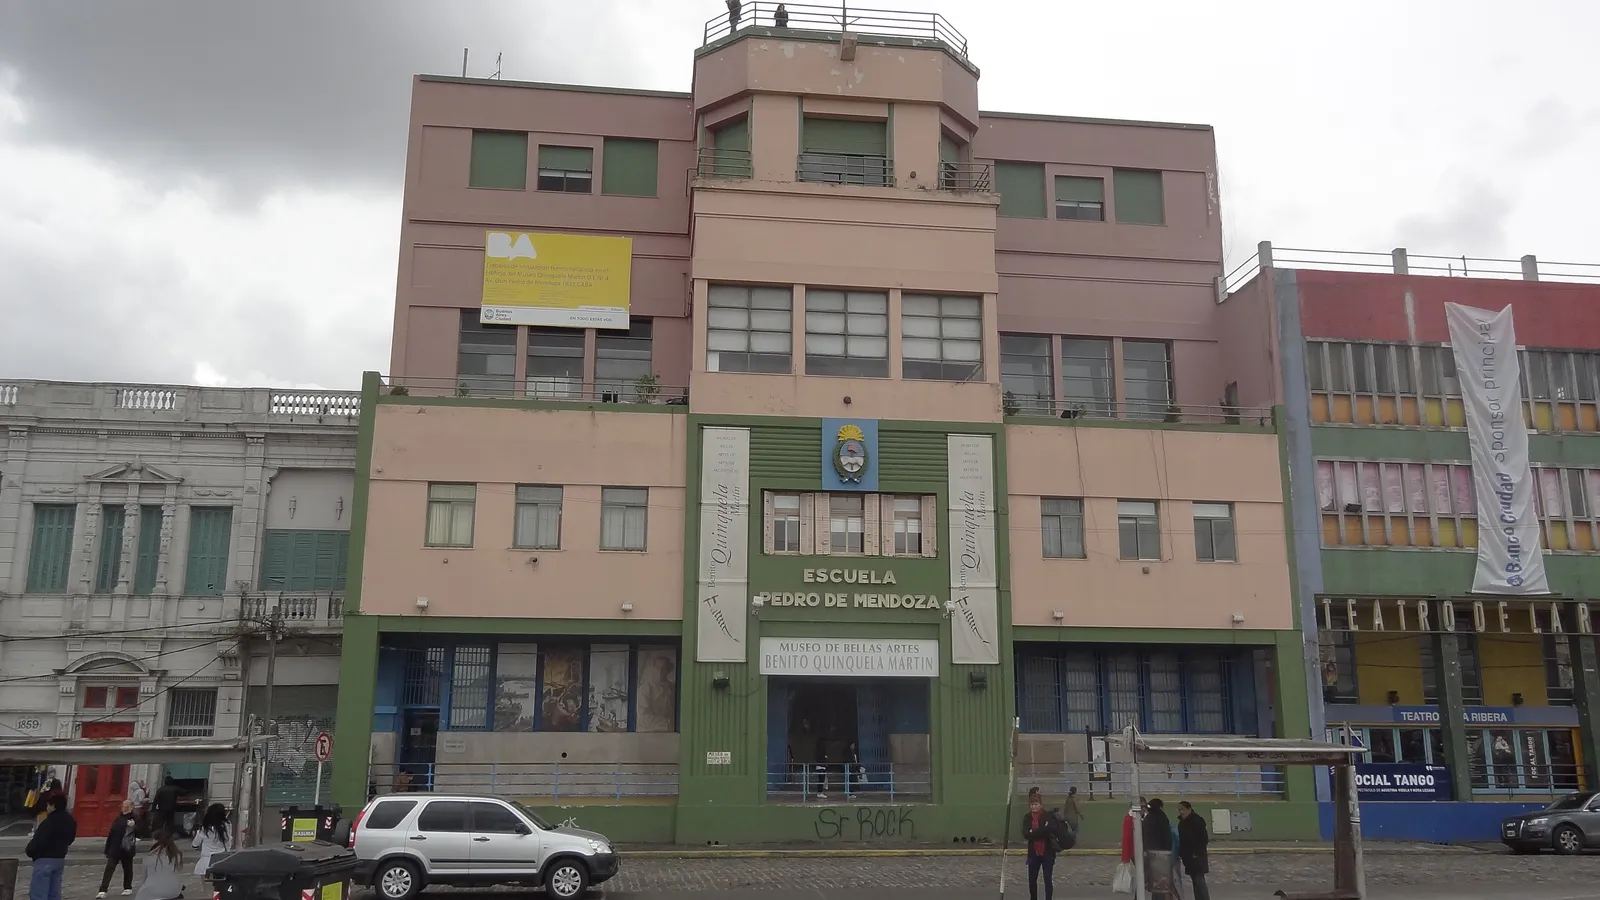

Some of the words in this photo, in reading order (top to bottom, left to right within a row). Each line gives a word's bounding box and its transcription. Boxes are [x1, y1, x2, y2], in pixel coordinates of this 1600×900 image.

[487, 233, 537, 261] BA
[1495, 472, 1518, 525] Ciudad
[710, 483, 733, 568] Quinquela
[959, 489, 981, 573] Quinquela
[1503, 526, 1523, 574] Banco
[707, 560, 717, 589] Benito
[803, 568, 897, 585] ESCUELA
[958, 564, 968, 592] Benito
[759, 591, 820, 608] PEDRO
[824, 592, 848, 608] DE
[854, 593, 941, 610] MENDOZA
[1322, 598, 1456, 632] TEATRO
[1473, 601, 1511, 633] DE
[1529, 602, 1563, 634] LA
[779, 642, 821, 653] MUSEO
[825, 643, 840, 653] DE
[843, 643, 882, 654] BELLAS
[886, 644, 920, 654] ARTES
[765, 654, 809, 669] BENITO
[813, 654, 884, 673] QUINQUELA
[888, 656, 933, 672] MARTIN
[16, 719, 39, 730] 1859
[1400, 711, 1440, 721] TEATRO
[1471, 712, 1508, 722] RIBERA
[1354, 774, 1391, 786] OCIAL
[1393, 774, 1434, 786] TANGO
[813, 807, 850, 839] Sr
[856, 807, 915, 841] ROCK
[227, 885, 233, 893] 4
